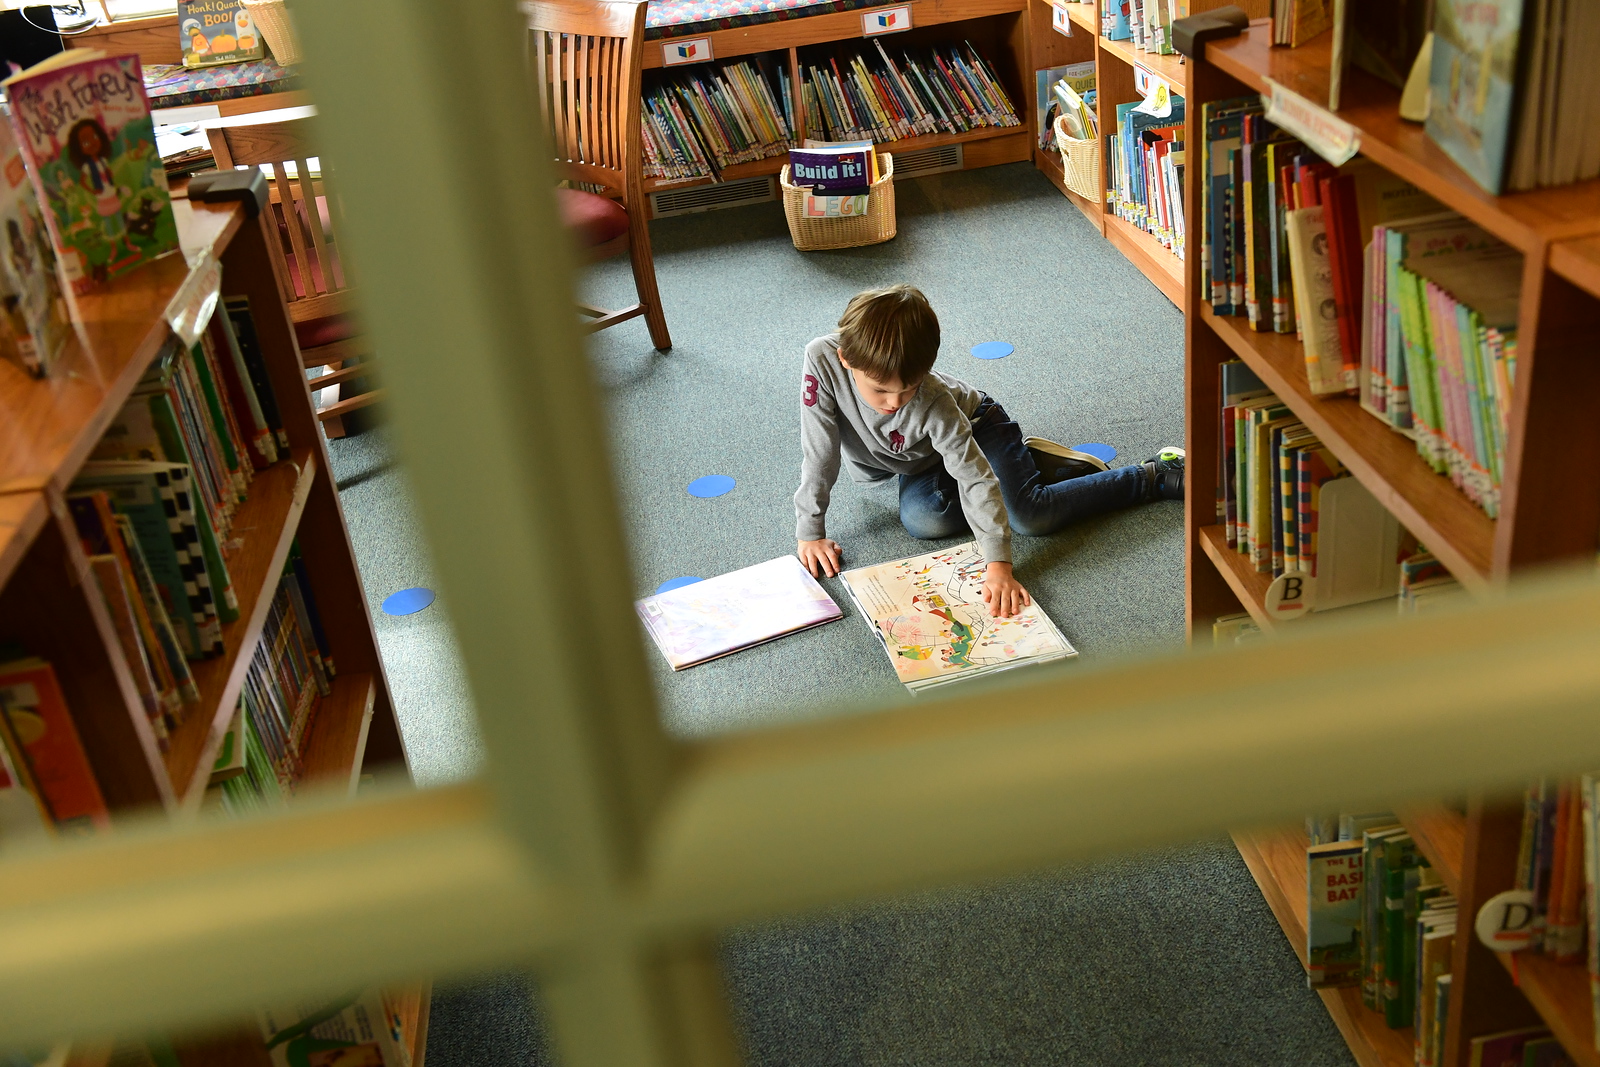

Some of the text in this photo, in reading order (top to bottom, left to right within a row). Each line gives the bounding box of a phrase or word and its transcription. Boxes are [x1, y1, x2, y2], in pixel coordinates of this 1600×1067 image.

[187, 2, 215, 15] Honk!
[204, 11, 233, 27] BOO!
[794, 162, 862, 180] Build It!
[807, 194, 866, 217] LEGO
[802, 374, 819, 407] 3
[1281, 576, 1303, 601] B
[1327, 887, 1359, 903] BAT
[1499, 902, 1533, 931] D
